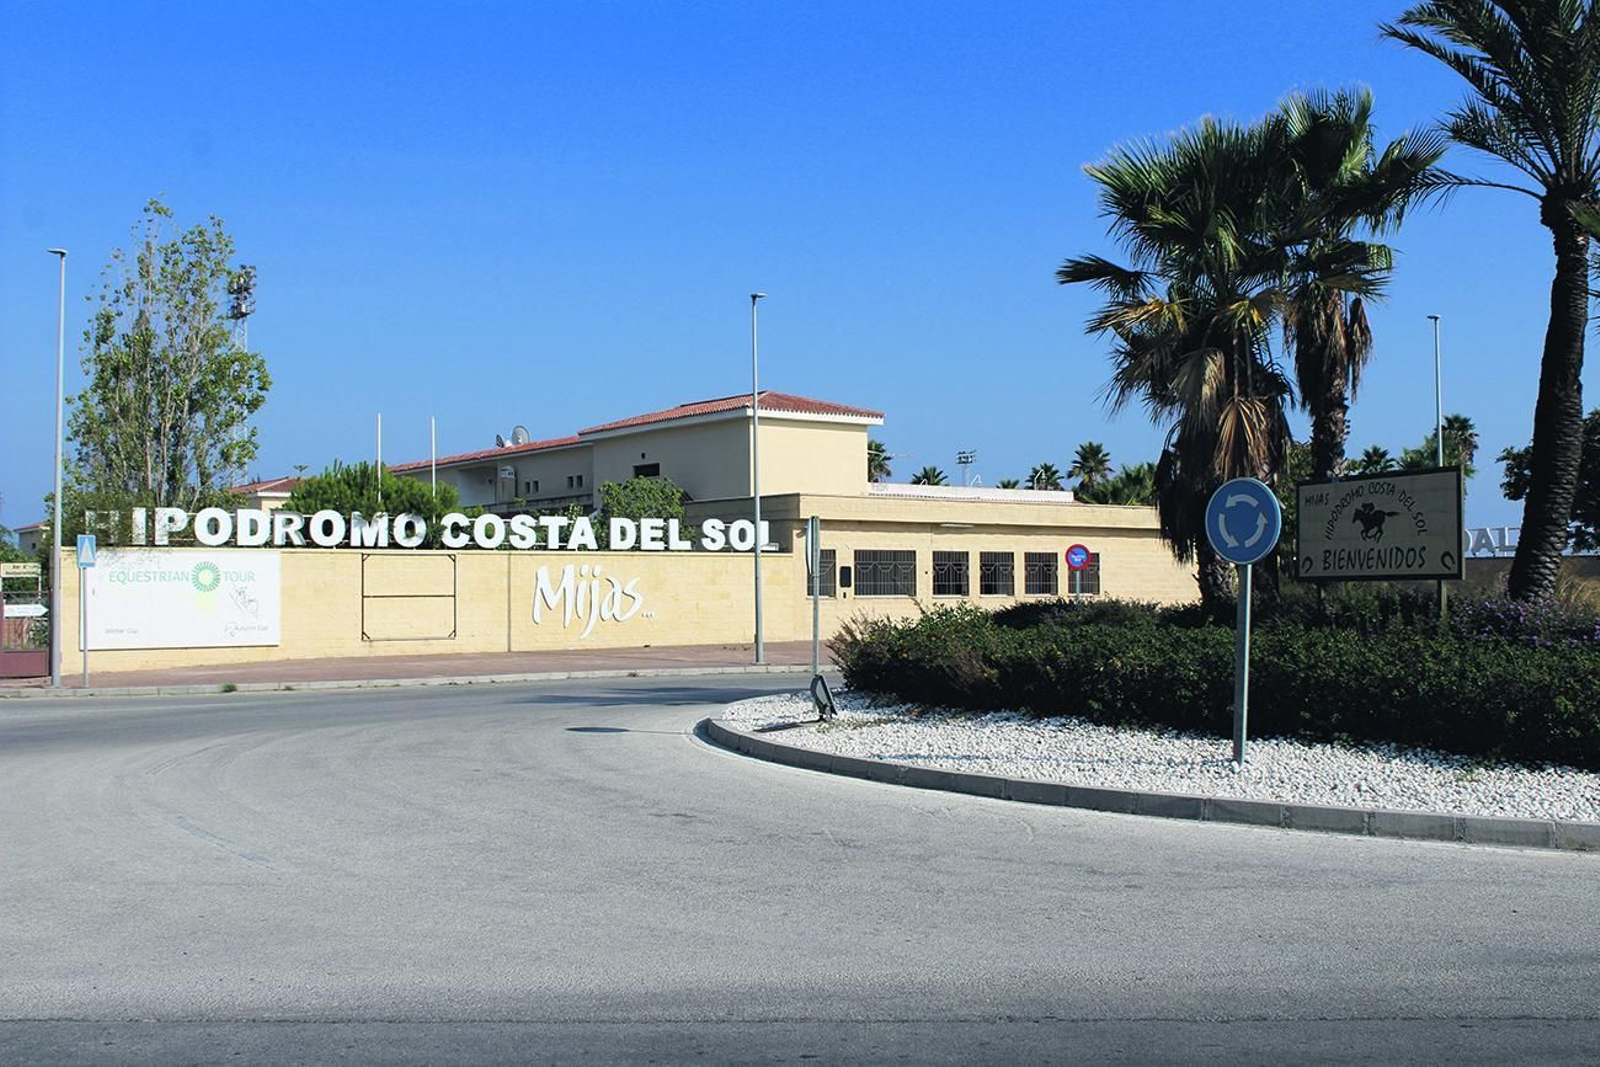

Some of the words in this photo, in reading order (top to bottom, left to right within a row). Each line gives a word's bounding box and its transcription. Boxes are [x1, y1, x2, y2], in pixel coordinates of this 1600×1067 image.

[1368, 482, 1397, 497] COSTA
[1398, 490, 1416, 512] DEL
[1412, 511, 1428, 536] SOL
[440, 512, 599, 551] COSTA
[609, 517, 692, 551] DEL
[701, 518, 779, 552] SOL
[1322, 546, 1427, 571] BIENVENIDOS
[108, 570, 190, 583] EQUESTRIAN
[222, 571, 256, 582] TOUR
